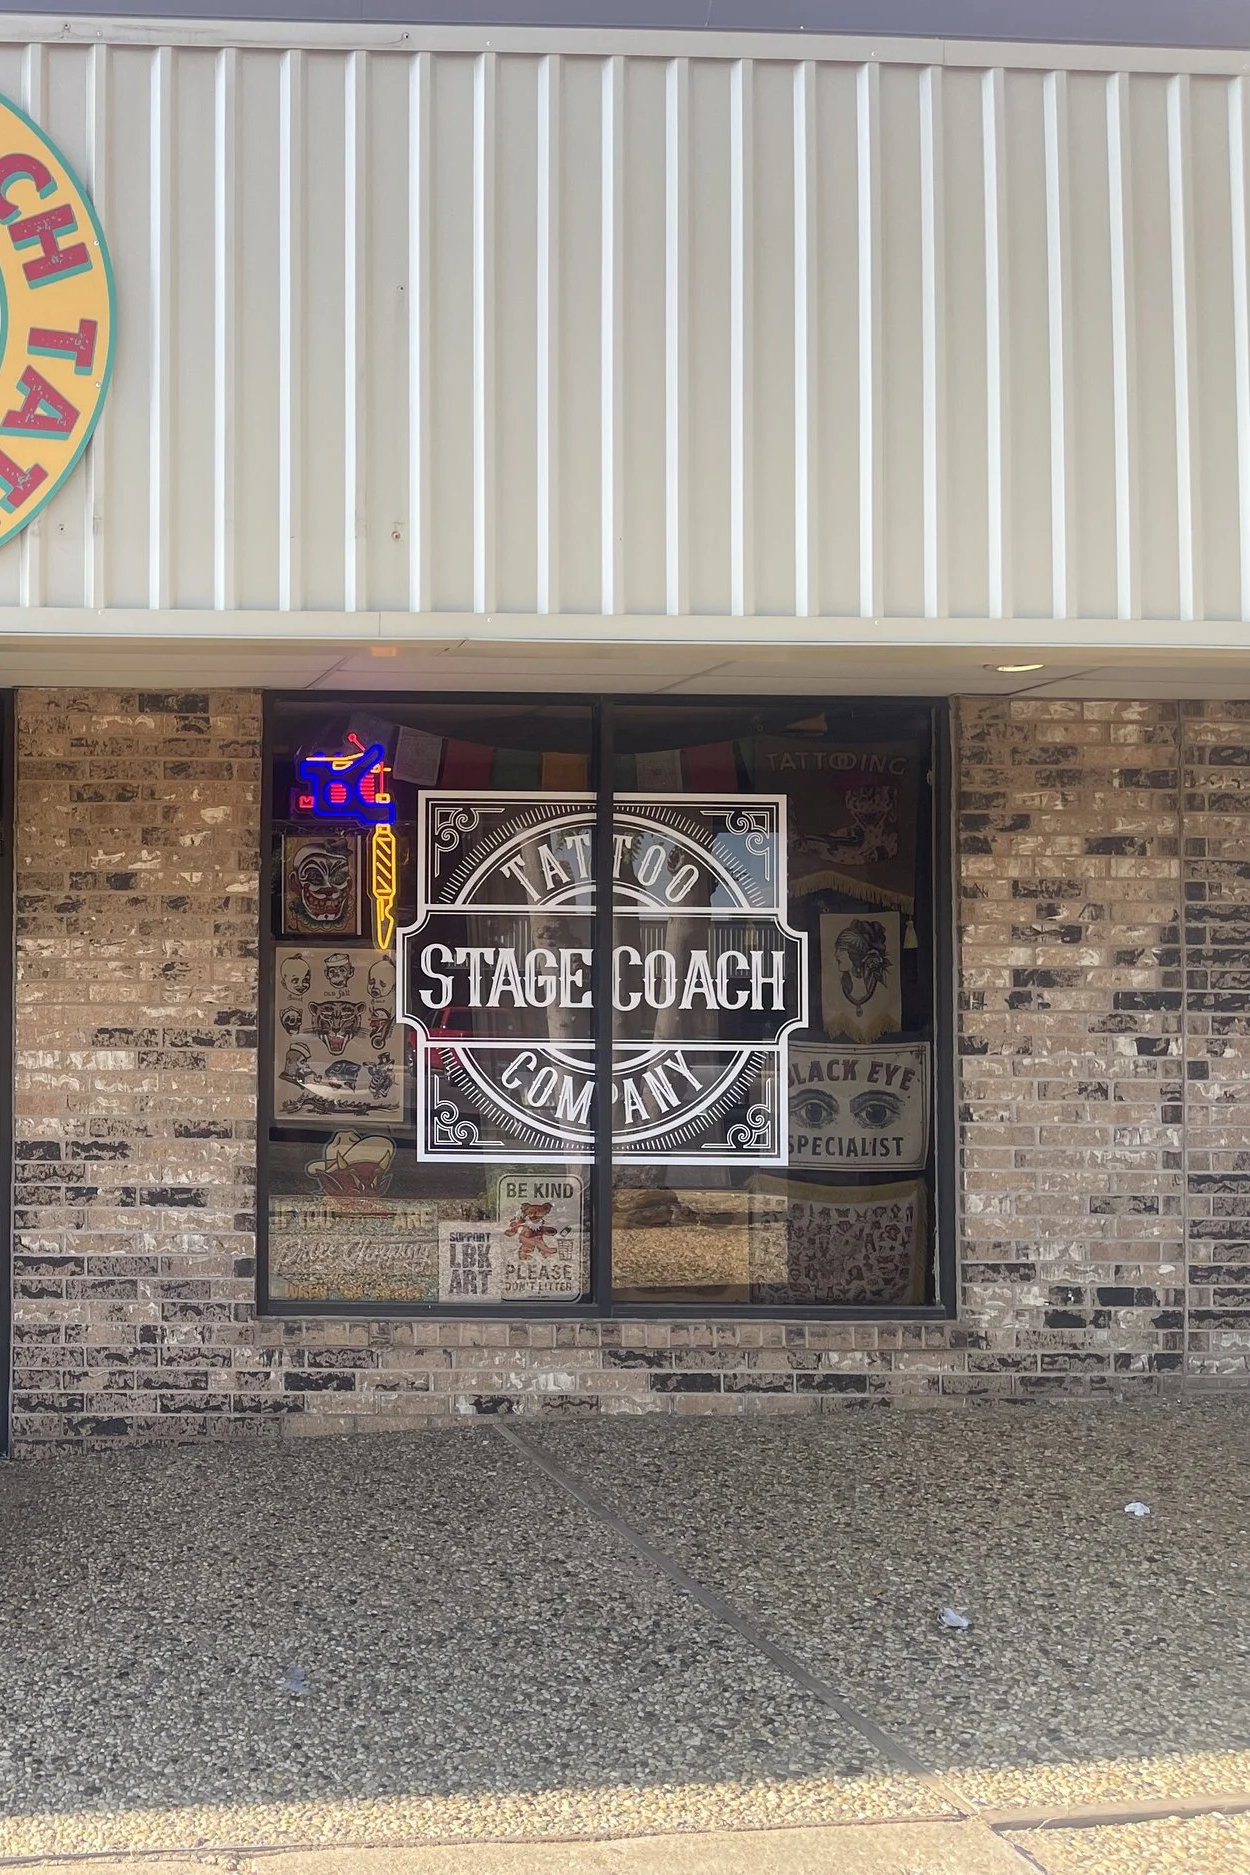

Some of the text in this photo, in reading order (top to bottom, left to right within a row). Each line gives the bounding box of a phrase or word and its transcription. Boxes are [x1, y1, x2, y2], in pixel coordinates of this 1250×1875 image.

[765, 752, 908, 776] TATTOOING
[502, 833, 700, 904] TATTOO
[418, 944, 785, 1012] STAGE COACH
[867, 1061, 915, 1091] EYE
[506, 1183, 574, 1198] BE KIND
[449, 1232, 491, 1242] SUPPORT
[449, 1269, 493, 1294] ART
[505, 1264, 572, 1280] PLEASE
